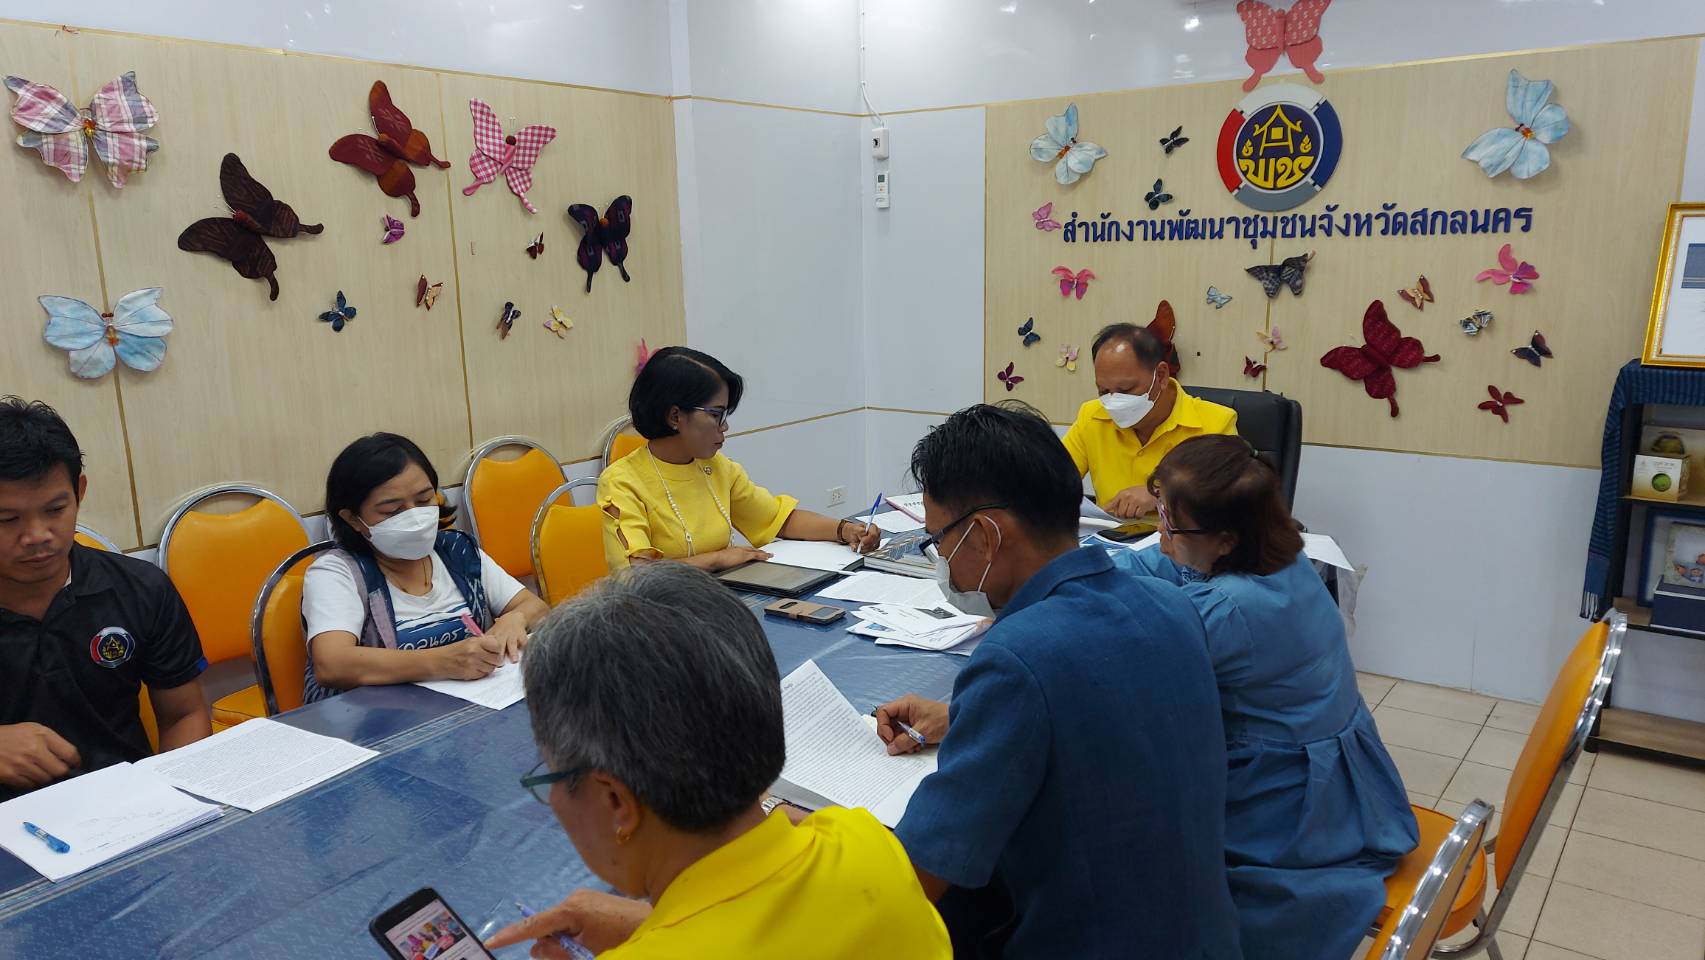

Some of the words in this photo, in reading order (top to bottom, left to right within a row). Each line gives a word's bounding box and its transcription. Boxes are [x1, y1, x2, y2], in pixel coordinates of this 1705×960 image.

[1063, 202, 1534, 250] สำนักงานพัฒนาชุมชนจังหวัดสกลนคร
